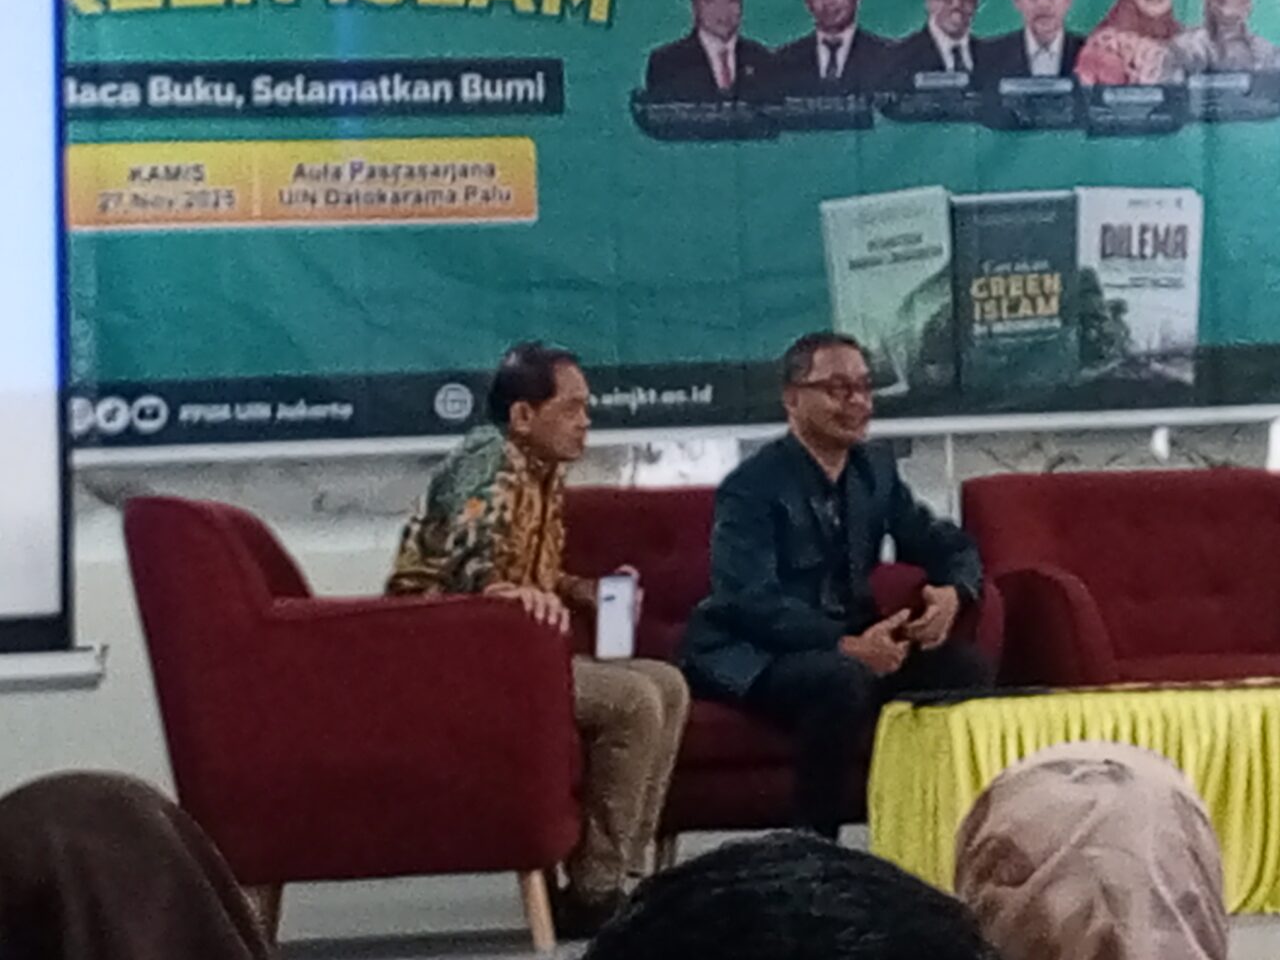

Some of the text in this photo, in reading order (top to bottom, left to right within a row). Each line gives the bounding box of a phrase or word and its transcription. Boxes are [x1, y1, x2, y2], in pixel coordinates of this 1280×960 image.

[147, 74, 245, 109] Buku,
[252, 72, 453, 106] Selamatkan
[460, 70, 545, 104] Bumi
